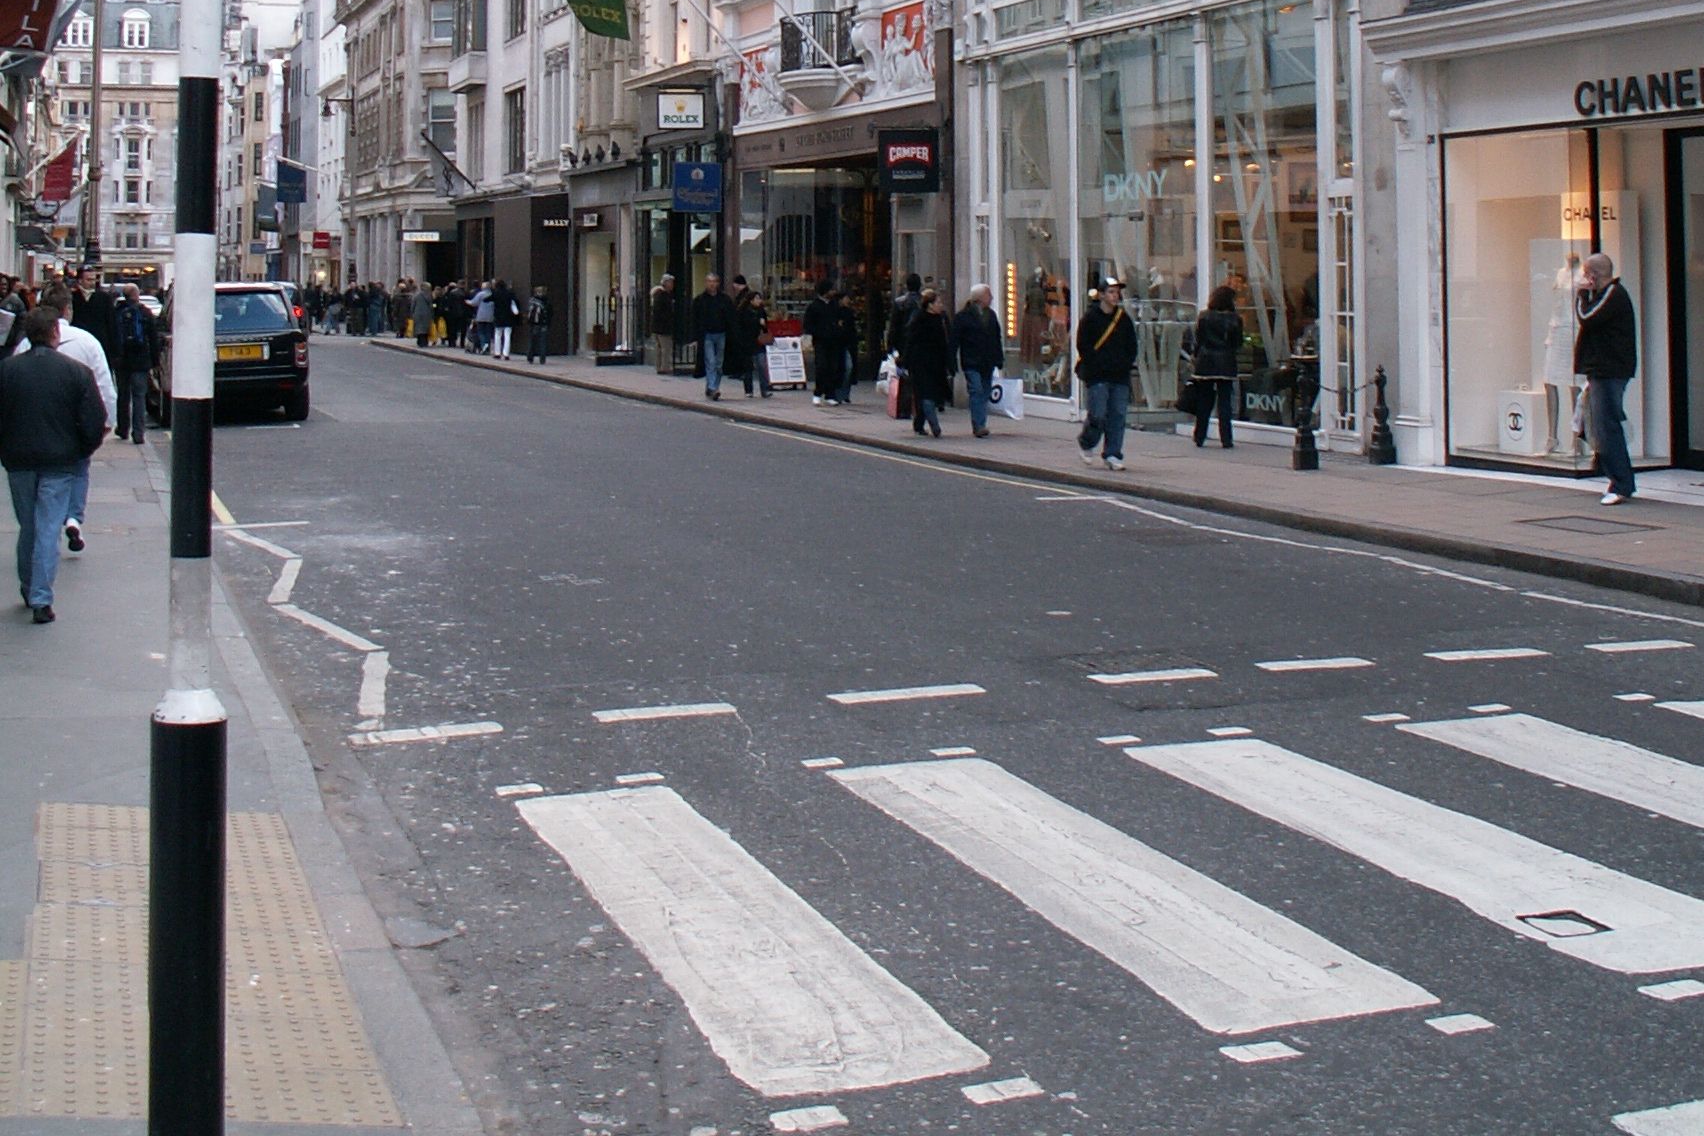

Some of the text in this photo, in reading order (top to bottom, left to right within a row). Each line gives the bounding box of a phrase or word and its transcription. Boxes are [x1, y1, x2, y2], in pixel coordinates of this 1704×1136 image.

[570, 4, 621, 24] ROLEX
[1573, 68, 1704, 116] CHANE
[663, 114, 699, 124] ROLEX
[889, 146, 929, 162] CAMPER
[1104, 167, 1168, 202] DKNY
[1563, 206, 1617, 222] CHAEL
[1245, 392, 1287, 413] DKNY
